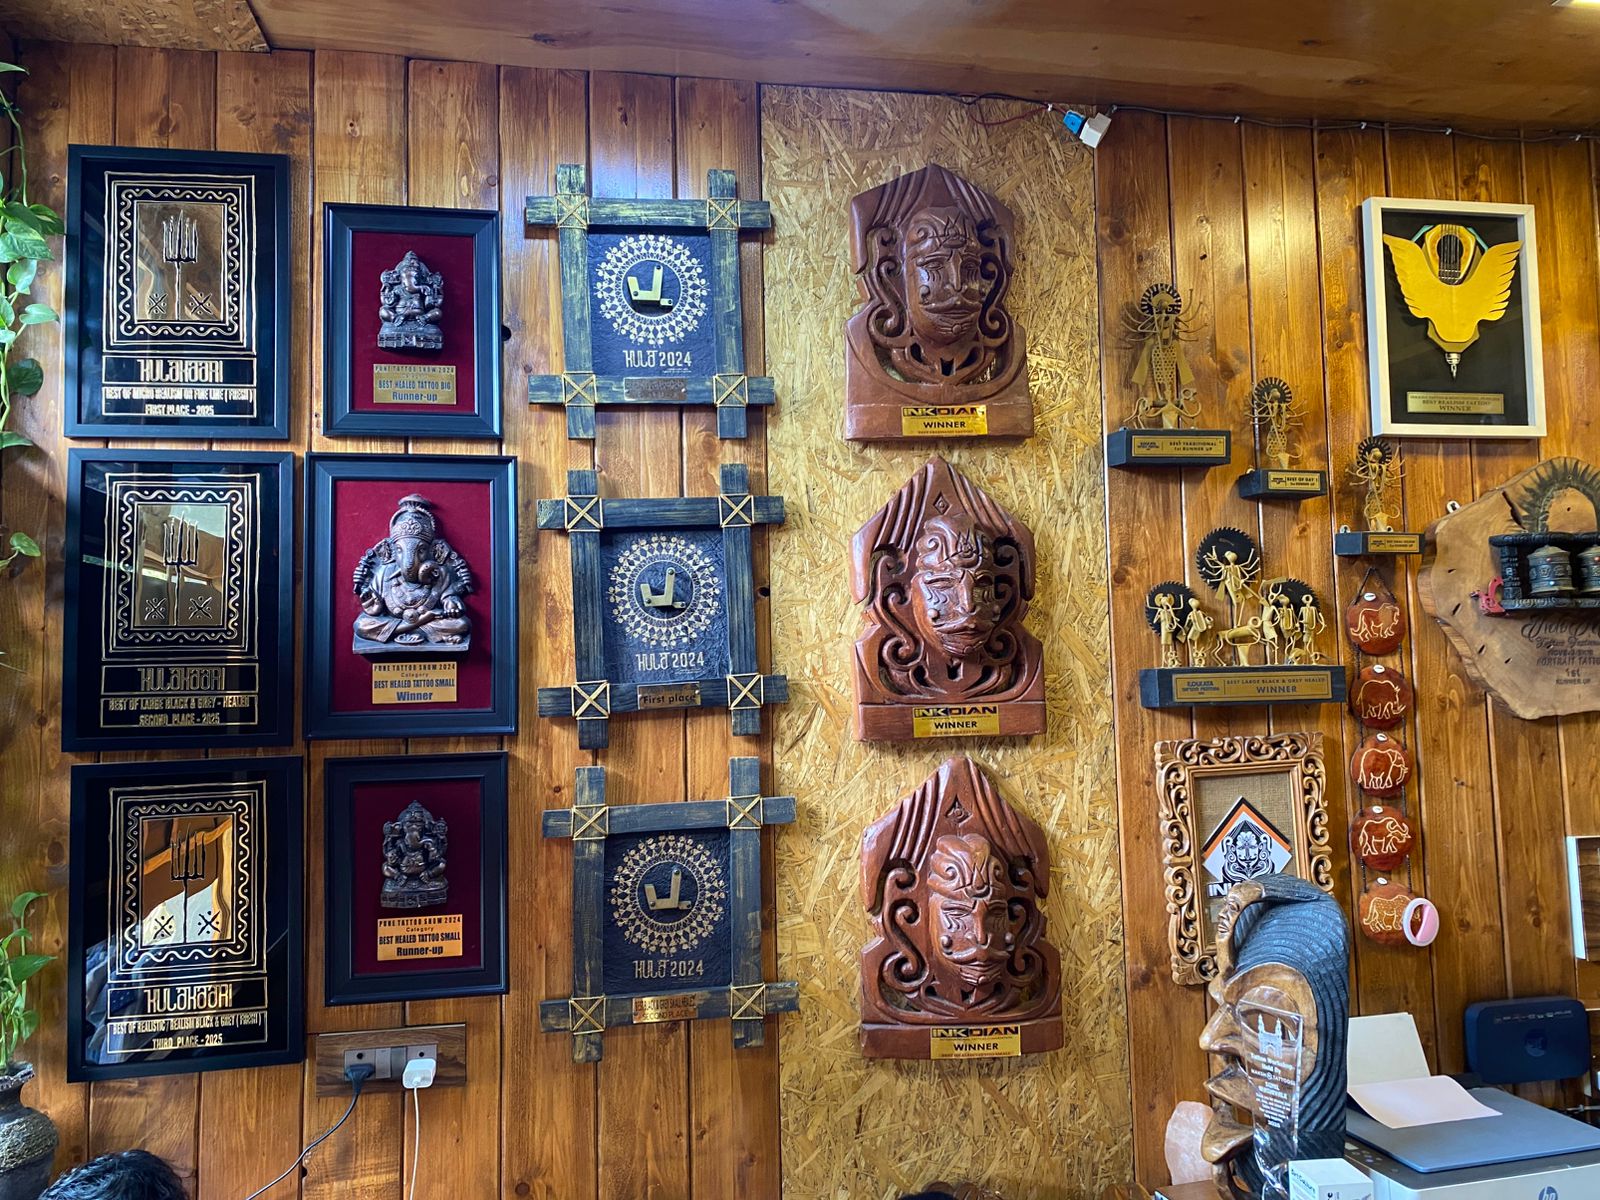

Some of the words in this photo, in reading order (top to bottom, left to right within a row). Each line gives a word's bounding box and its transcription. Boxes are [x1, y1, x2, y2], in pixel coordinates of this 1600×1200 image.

[659, 352, 692, 366] 2024
[378, 380, 392, 388] BEST
[418, 381, 438, 390] TATTOO
[441, 382, 451, 390] BIG
[106, 388, 120, 400] BEST
[122, 388, 132, 400] OF
[392, 392, 438, 402] Runner-up
[145, 404, 166, 415] FIRST
[167, 404, 190, 416] PLACE
[196, 405, 214, 416] 2025
[672, 652, 704, 668] 2024
[390, 680, 411, 688] HEALED
[413, 680, 434, 688] TATTOO
[435, 679, 454, 687] SMALL
[396, 692, 432, 701] Winner
[643, 694, 664, 704] First
[668, 694, 696, 704] place
[109, 698, 126, 711] BEST
[129, 698, 139, 710] OF
[140, 698, 163, 710] LARGE
[165, 698, 188, 710] BLACK
[198, 697, 216, 708] GREY
[223, 696, 250, 708] HEALED
[914, 706, 996, 718] INKDIAN
[139, 714, 168, 726] SECOND
[172, 714, 195, 726] PLACE
[202, 713, 220, 724] 2025
[934, 721, 977, 729] WINNER
[379, 936, 393, 944] BEST
[395, 934, 416, 943] HEALED
[418, 933, 439, 942] TATTOO
[440, 932, 460, 941] SMALL
[397, 946, 443, 956] Runner-up
[670, 960, 704, 977] 2024
[113, 1022, 127, 1035] BEST
[128, 1022, 136, 1034] OF
[137, 1020, 165, 1033] REALISTIC
[170, 1018, 194, 1031] REALISM
[196, 1016, 213, 1029] BLACK
[220, 1015, 235, 1026] GREY
[932, 1026, 1018, 1038] INKDIAN
[152, 1038, 172, 1049] THIRD
[177, 1036, 198, 1048] PLACE
[205, 1033, 222, 1045] 2025
[953, 1043, 998, 1051] WINNER
